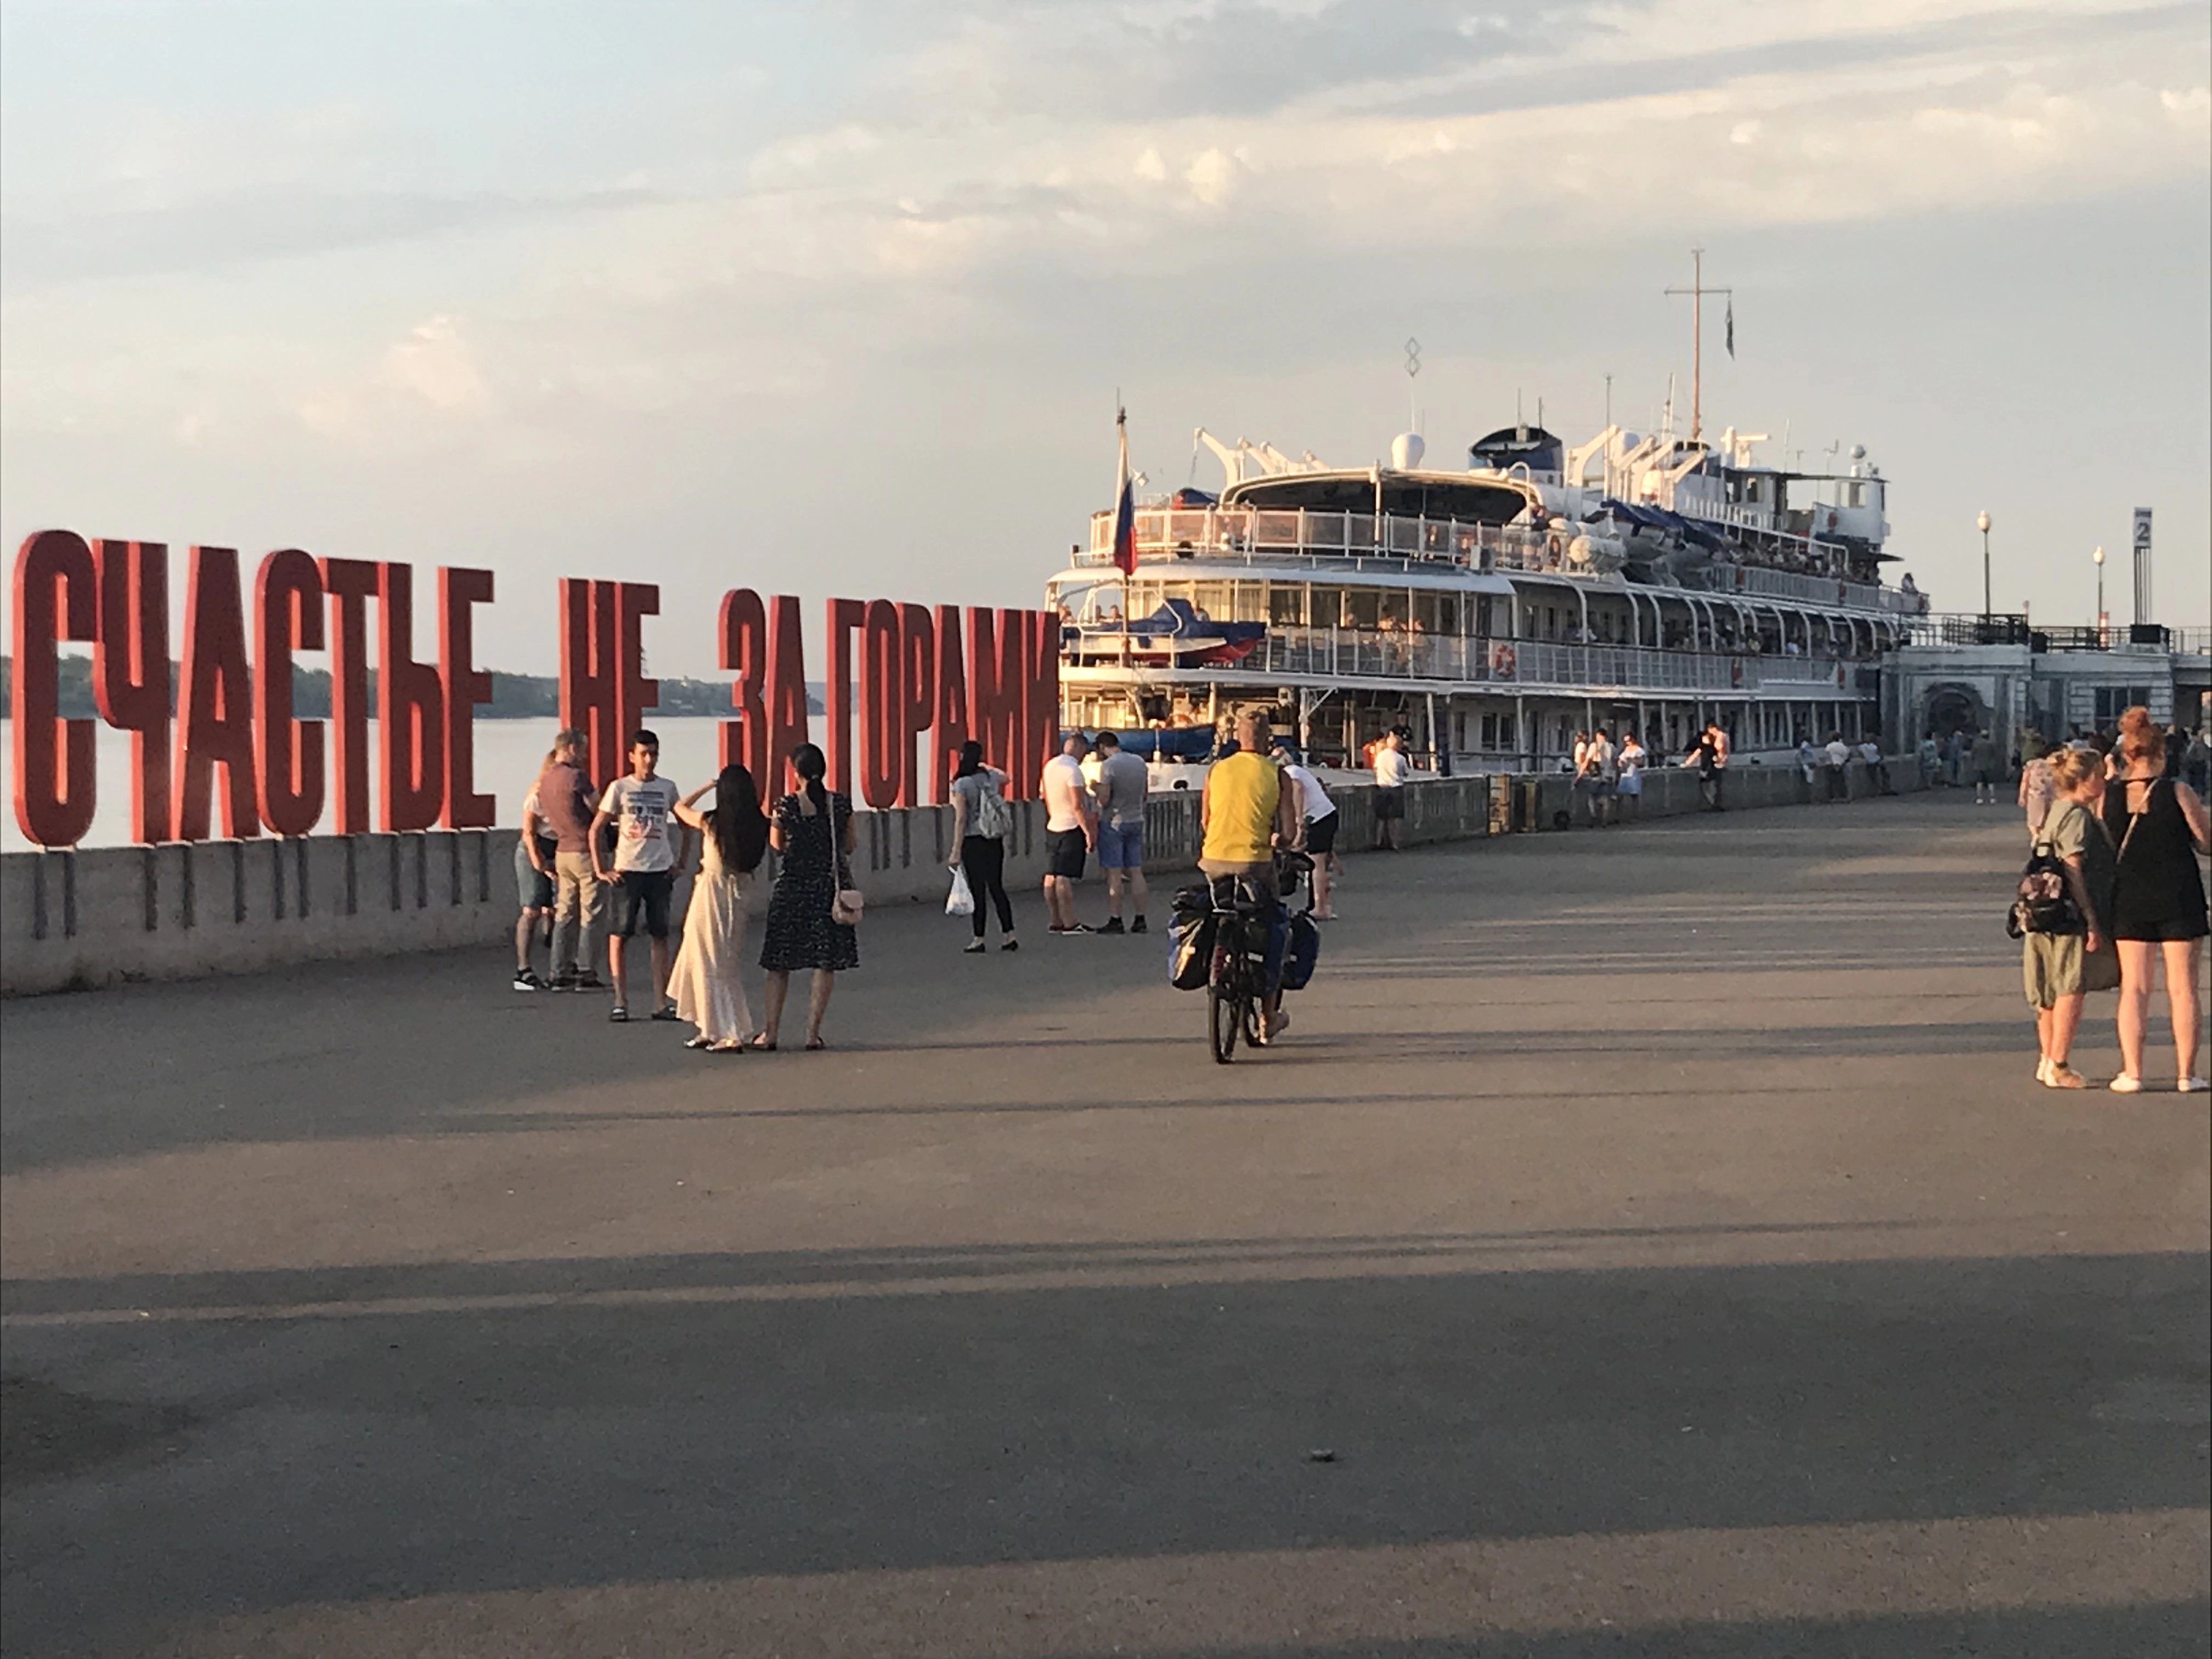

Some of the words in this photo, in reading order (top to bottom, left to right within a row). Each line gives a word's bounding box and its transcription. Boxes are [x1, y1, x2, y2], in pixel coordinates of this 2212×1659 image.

[2137, 522, 2149, 541] 2
[12, 530, 495, 845] СЧАСТЬЕ
[559, 577, 660, 795] НЕ
[718, 589, 809, 816] ЗА
[827, 597, 1060, 808] ГОРАМИ
